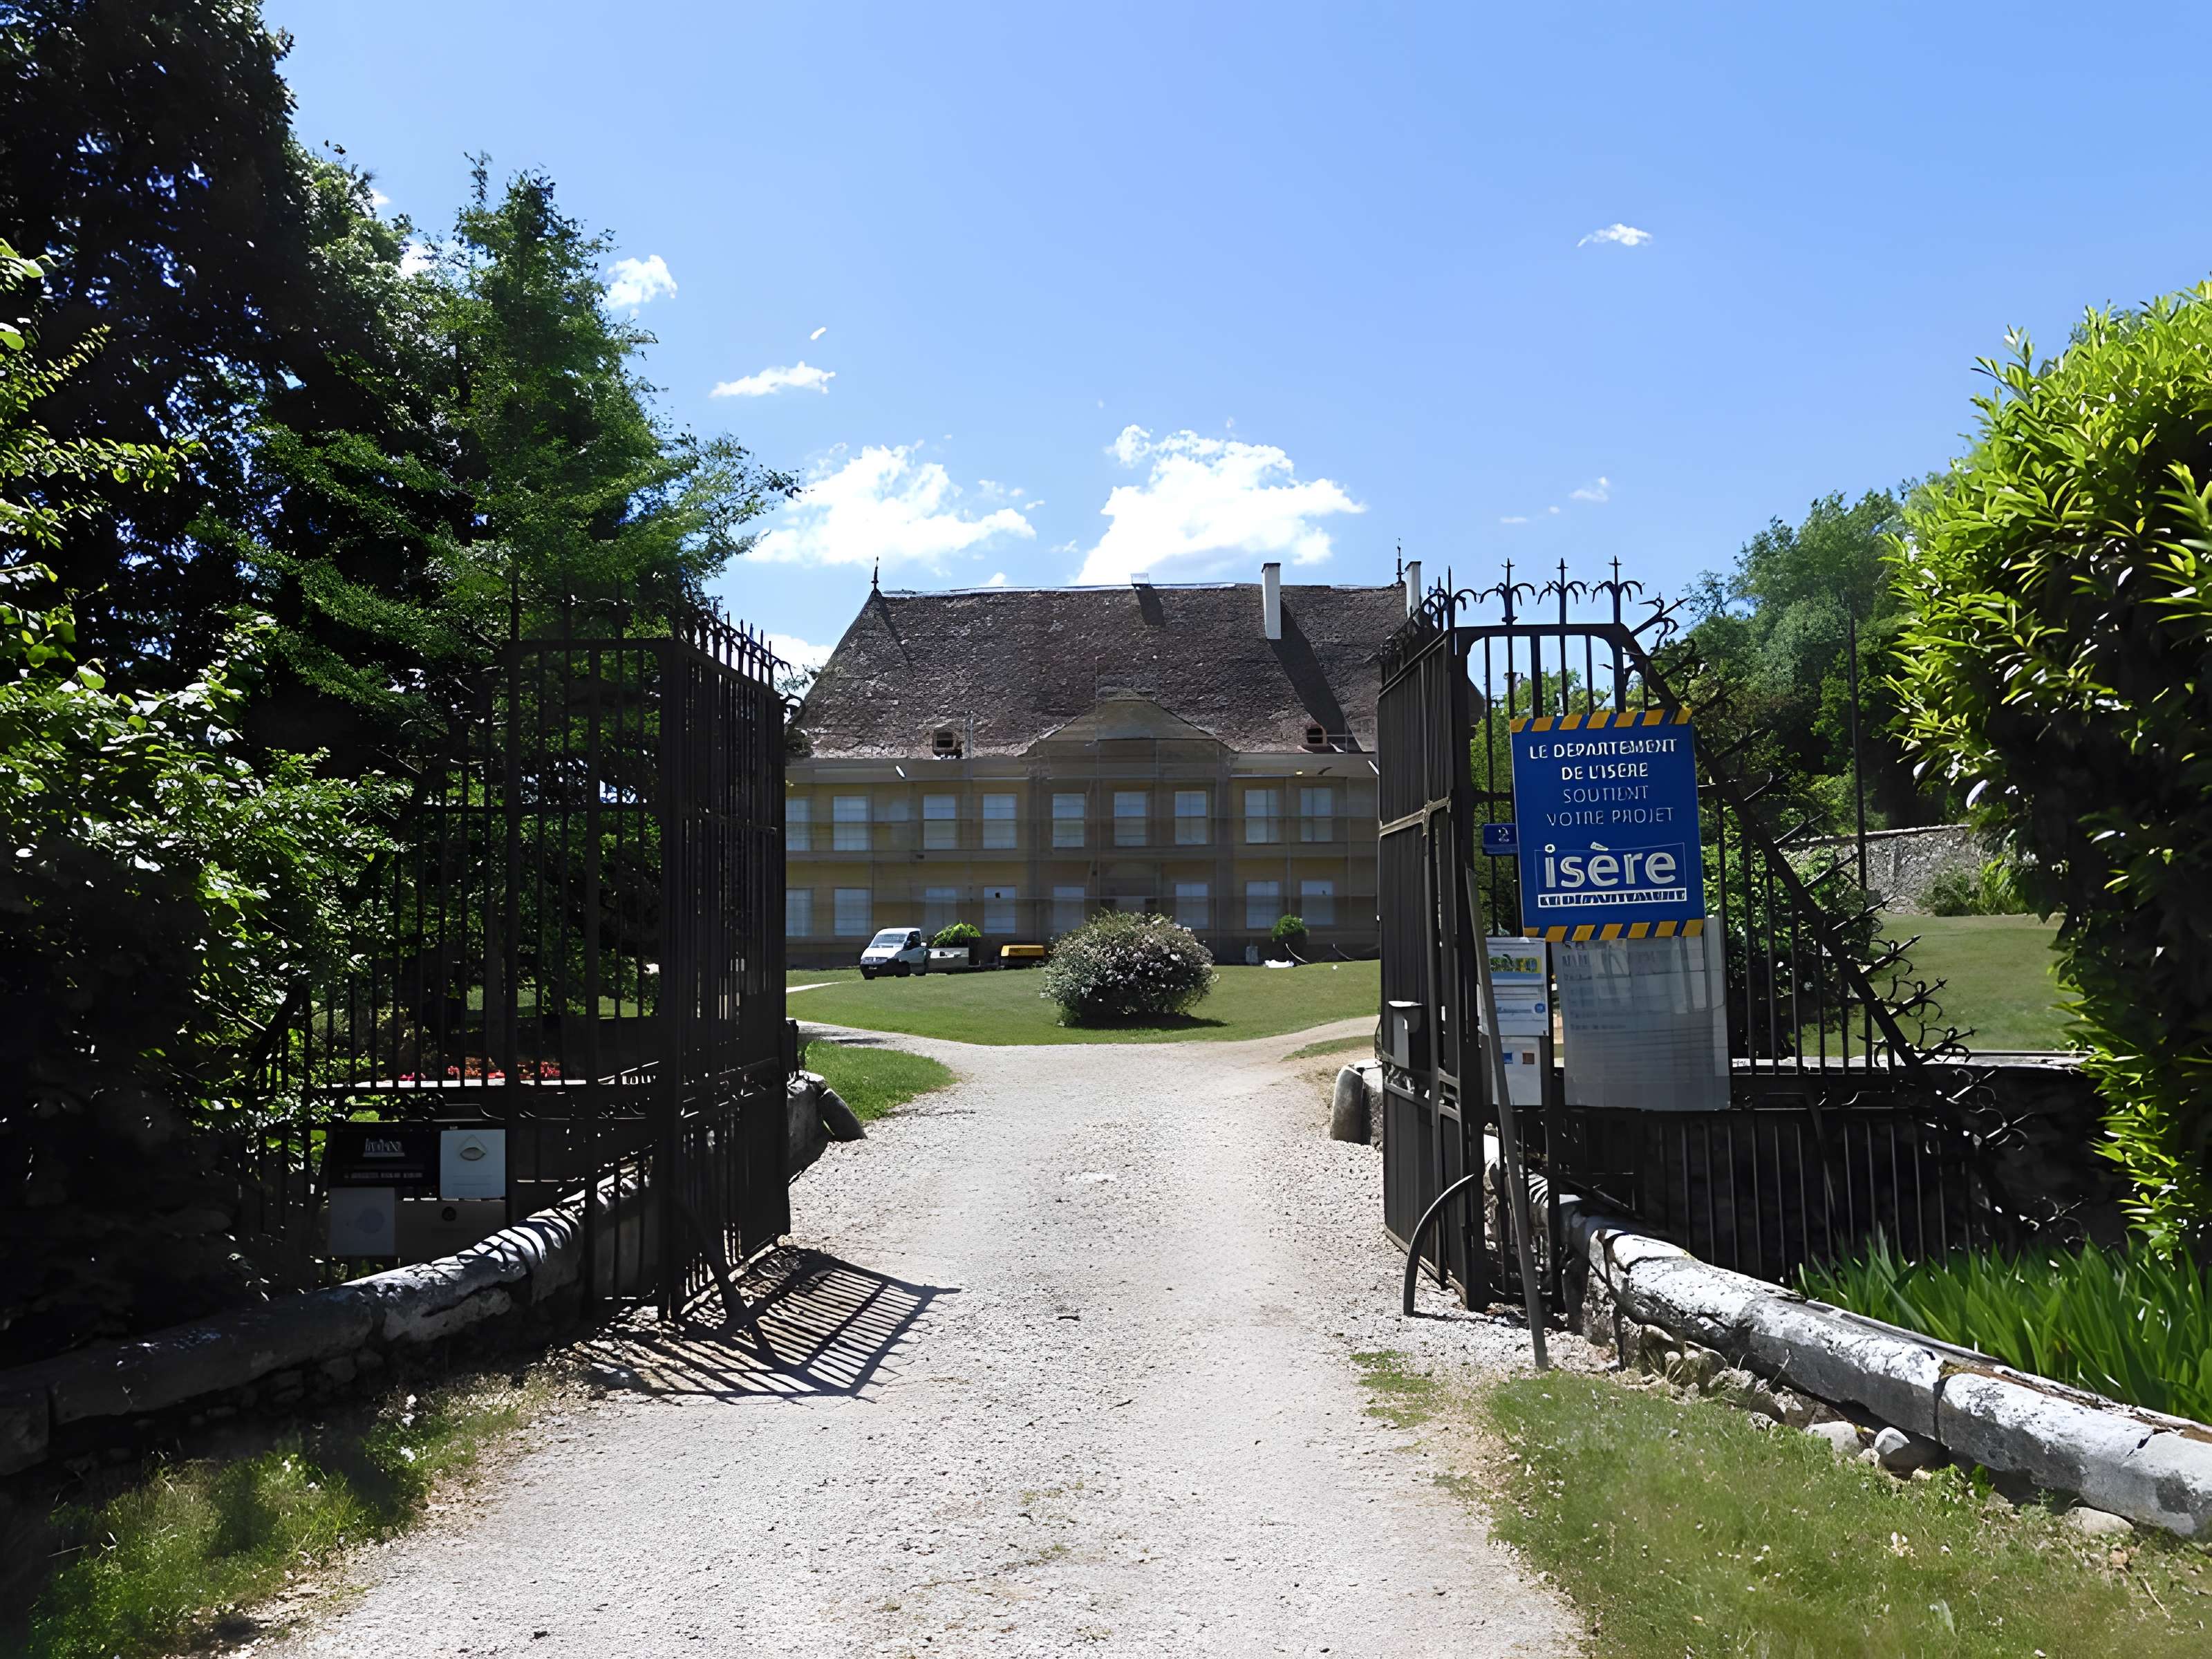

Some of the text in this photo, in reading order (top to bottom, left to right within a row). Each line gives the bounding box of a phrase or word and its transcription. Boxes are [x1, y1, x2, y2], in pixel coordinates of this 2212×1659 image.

[1529, 744, 1548, 760] LE
[1561, 766, 1584, 780] DE
[1563, 785, 1649, 803] SOUTIENT
[1546, 807, 1674, 827] VOTRE PROJET
[1544, 841, 1677, 888] isère
